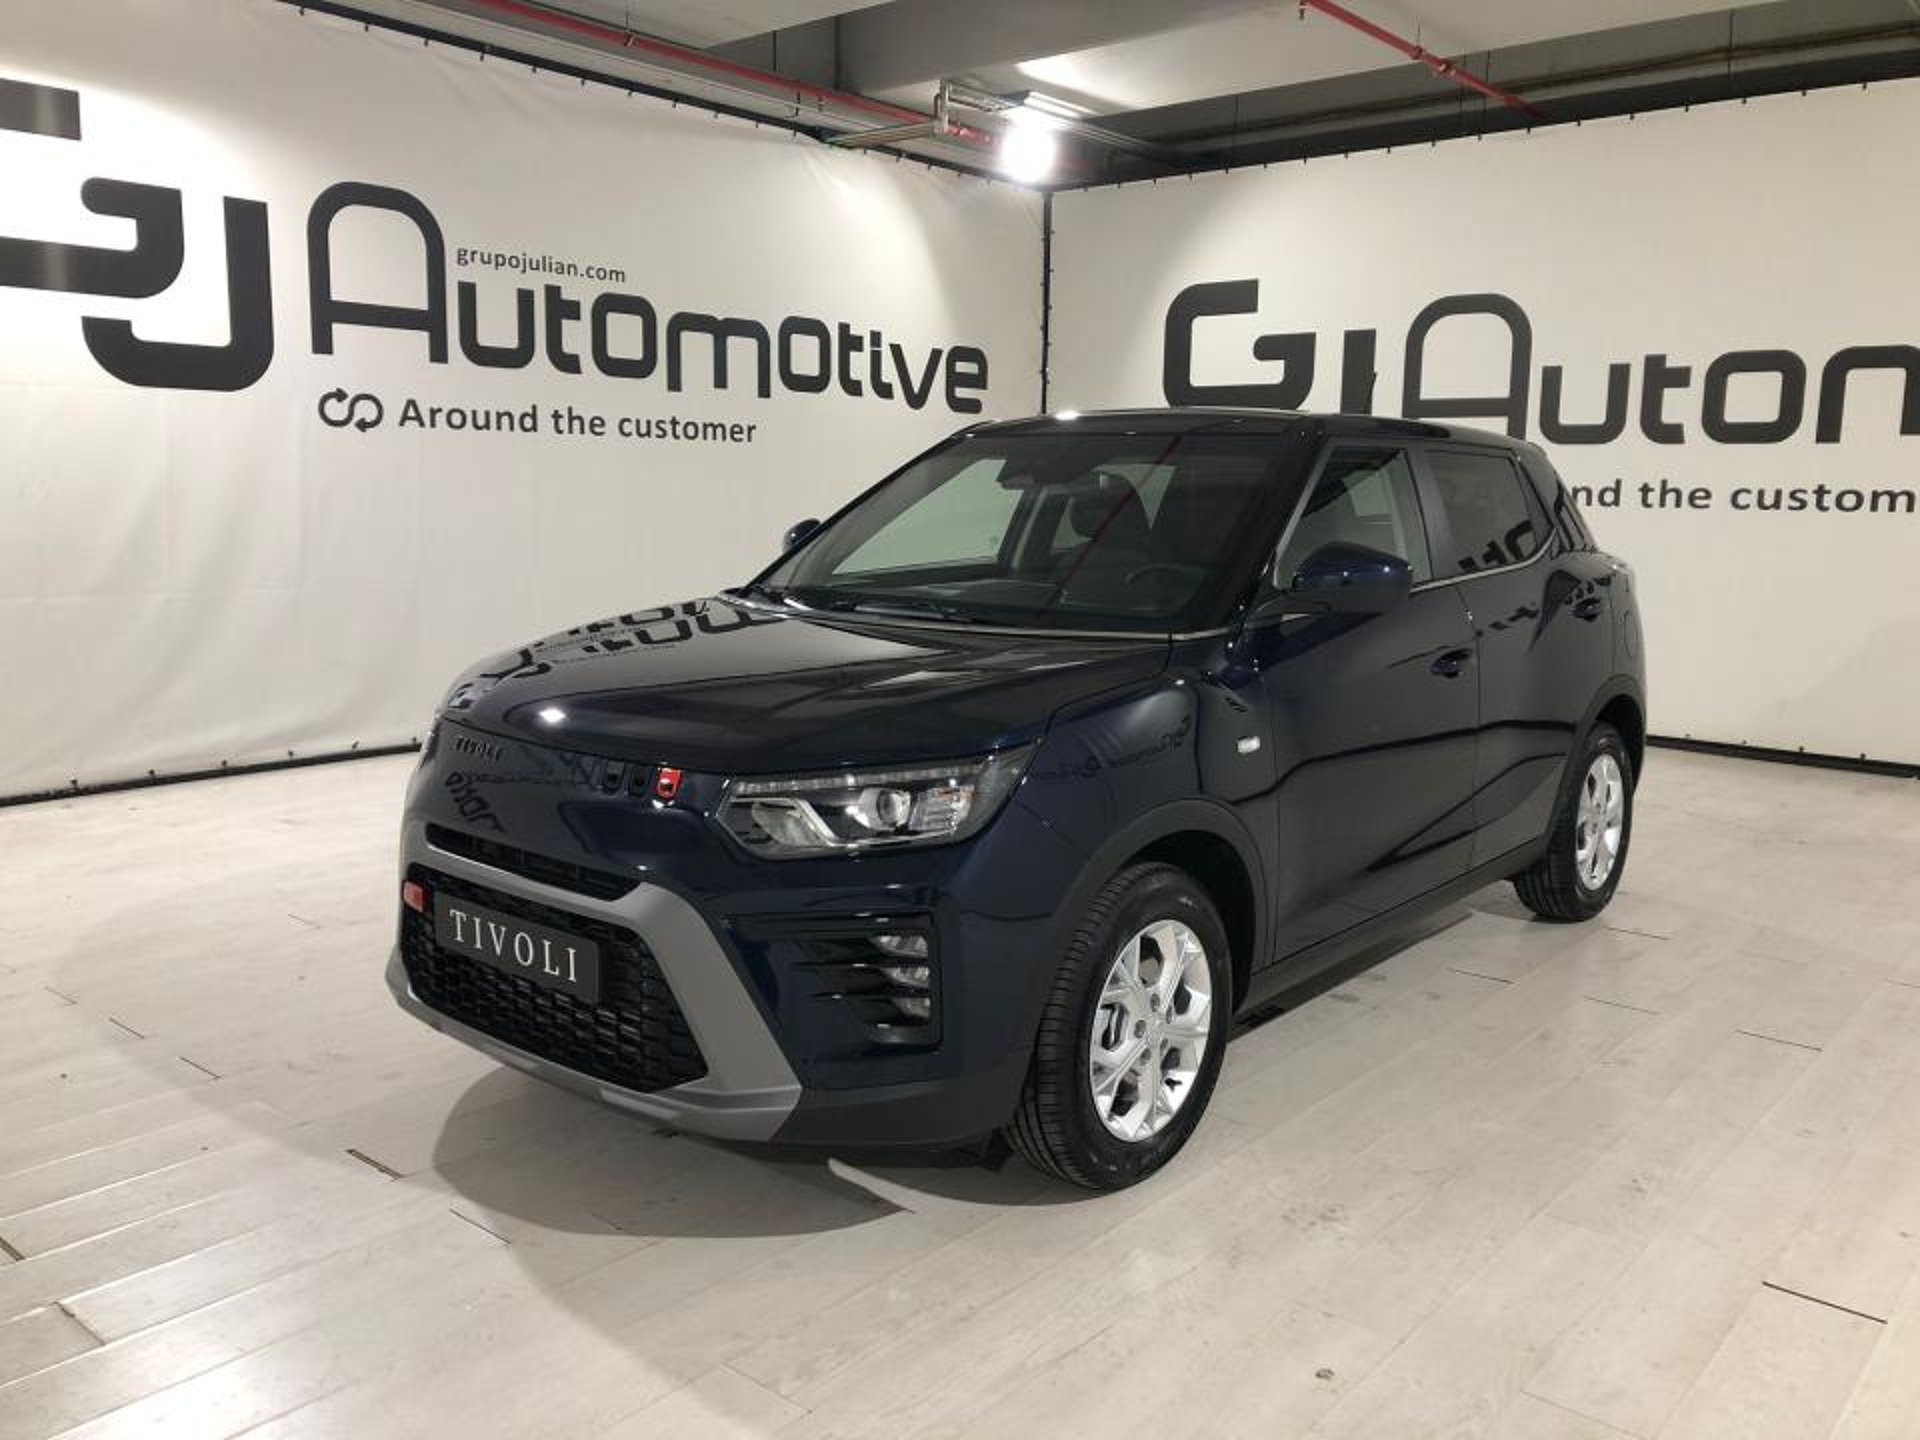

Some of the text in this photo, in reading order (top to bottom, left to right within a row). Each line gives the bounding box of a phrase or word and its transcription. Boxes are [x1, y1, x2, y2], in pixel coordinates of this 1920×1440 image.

[457, 248, 626, 283] grupojulian.com
[399, 400, 757, 443] Around the customer
[1638, 479, 1712, 509] the
[450, 909, 577, 982] TIVOLI
